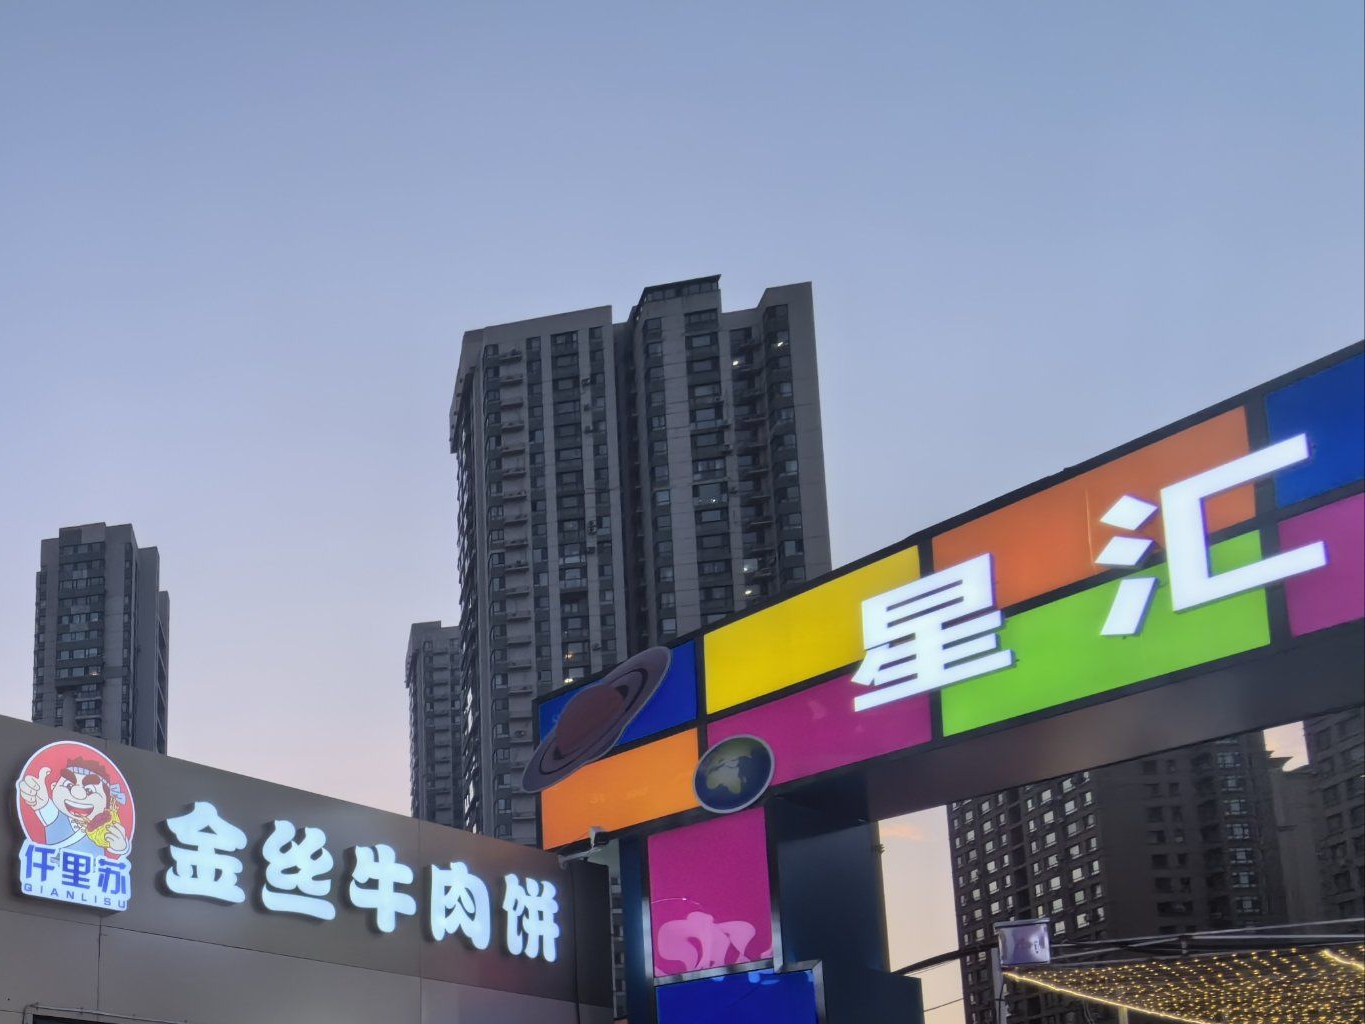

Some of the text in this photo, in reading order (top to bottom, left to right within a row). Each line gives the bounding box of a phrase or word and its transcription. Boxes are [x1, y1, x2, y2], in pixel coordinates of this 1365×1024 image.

[851, 432, 1328, 712] 星汇
[22, 881, 128, 909] QIANLISU
[23, 843, 128, 897] 仟里苏
[164, 800, 560, 963] 金丝牛肉饼
